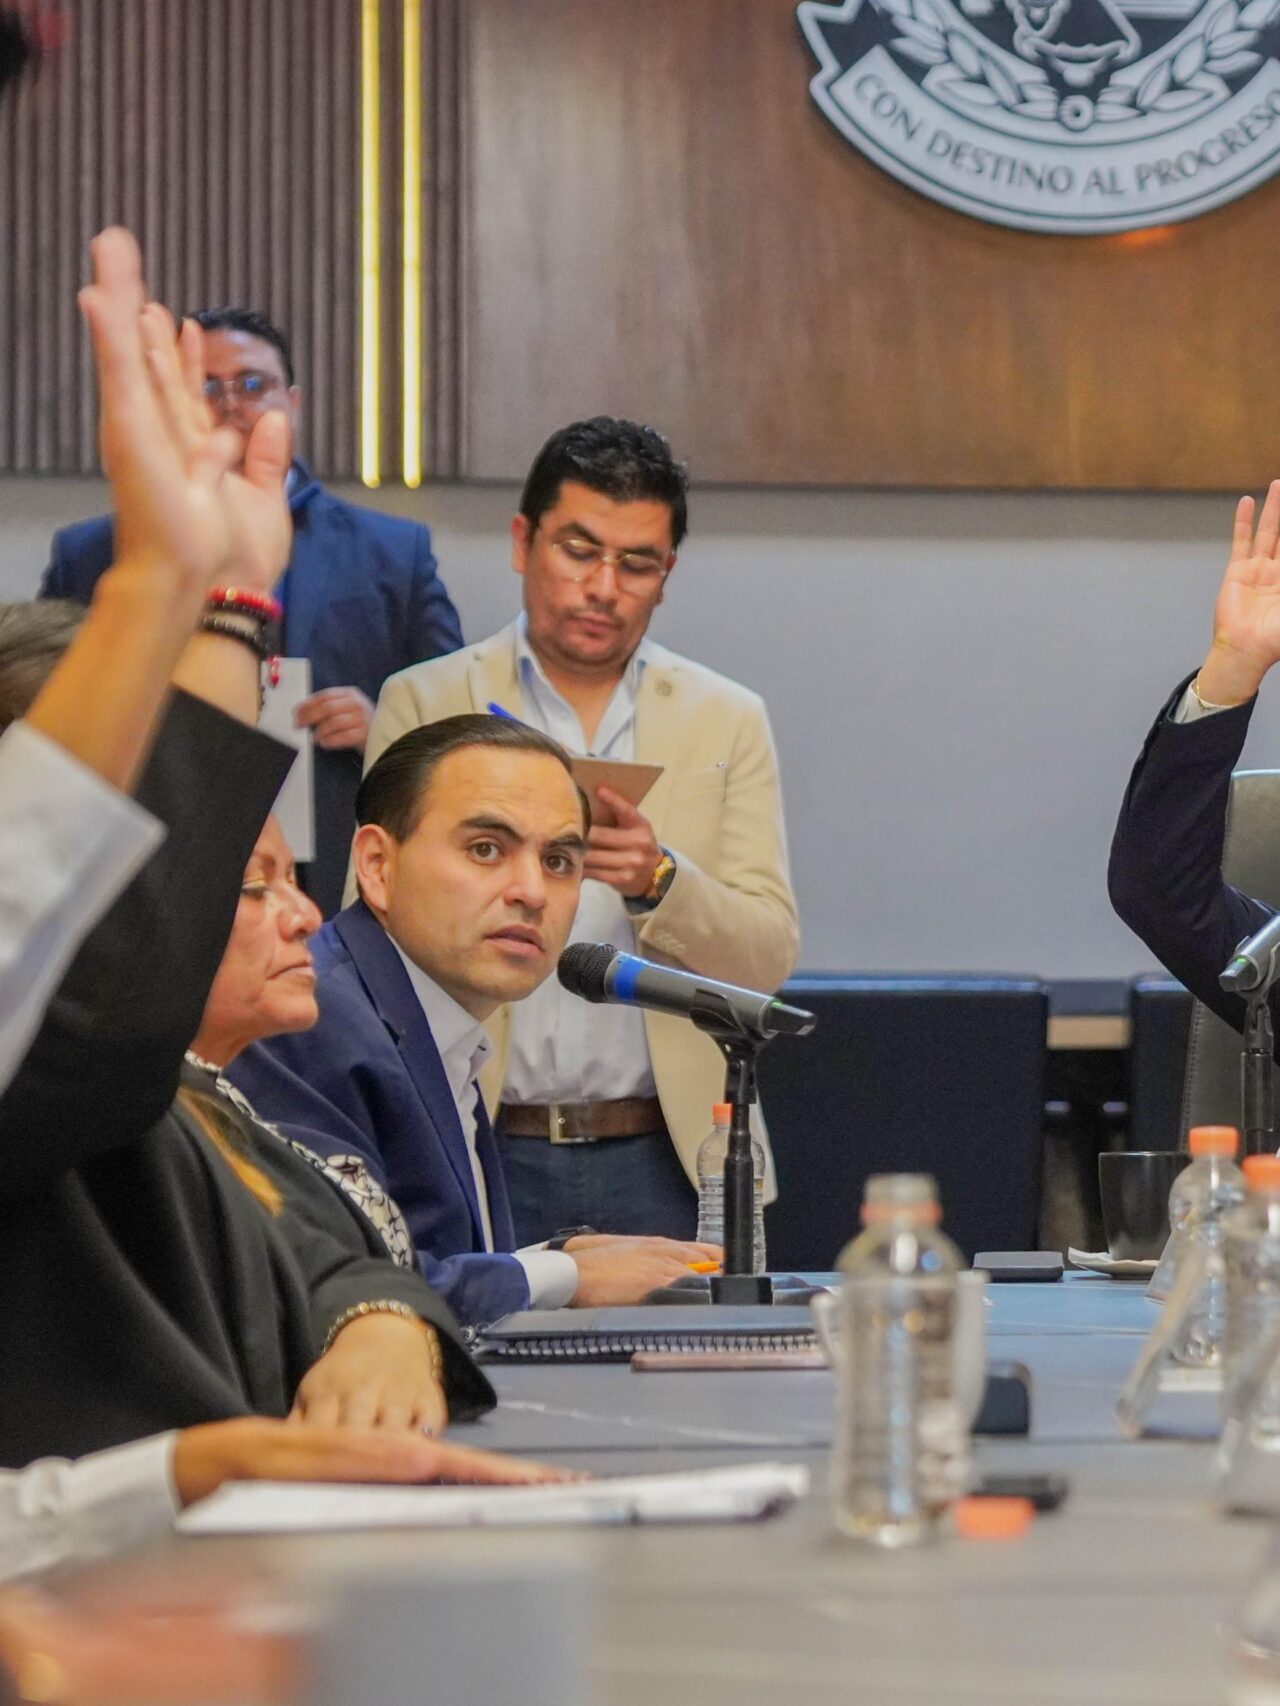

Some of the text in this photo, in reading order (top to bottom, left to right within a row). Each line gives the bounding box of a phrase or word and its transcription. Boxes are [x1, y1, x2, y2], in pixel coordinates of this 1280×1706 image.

[855, 73, 923, 140] CON
[926, 129, 1073, 193] DESTINO
[1083, 165, 1125, 194] AL
